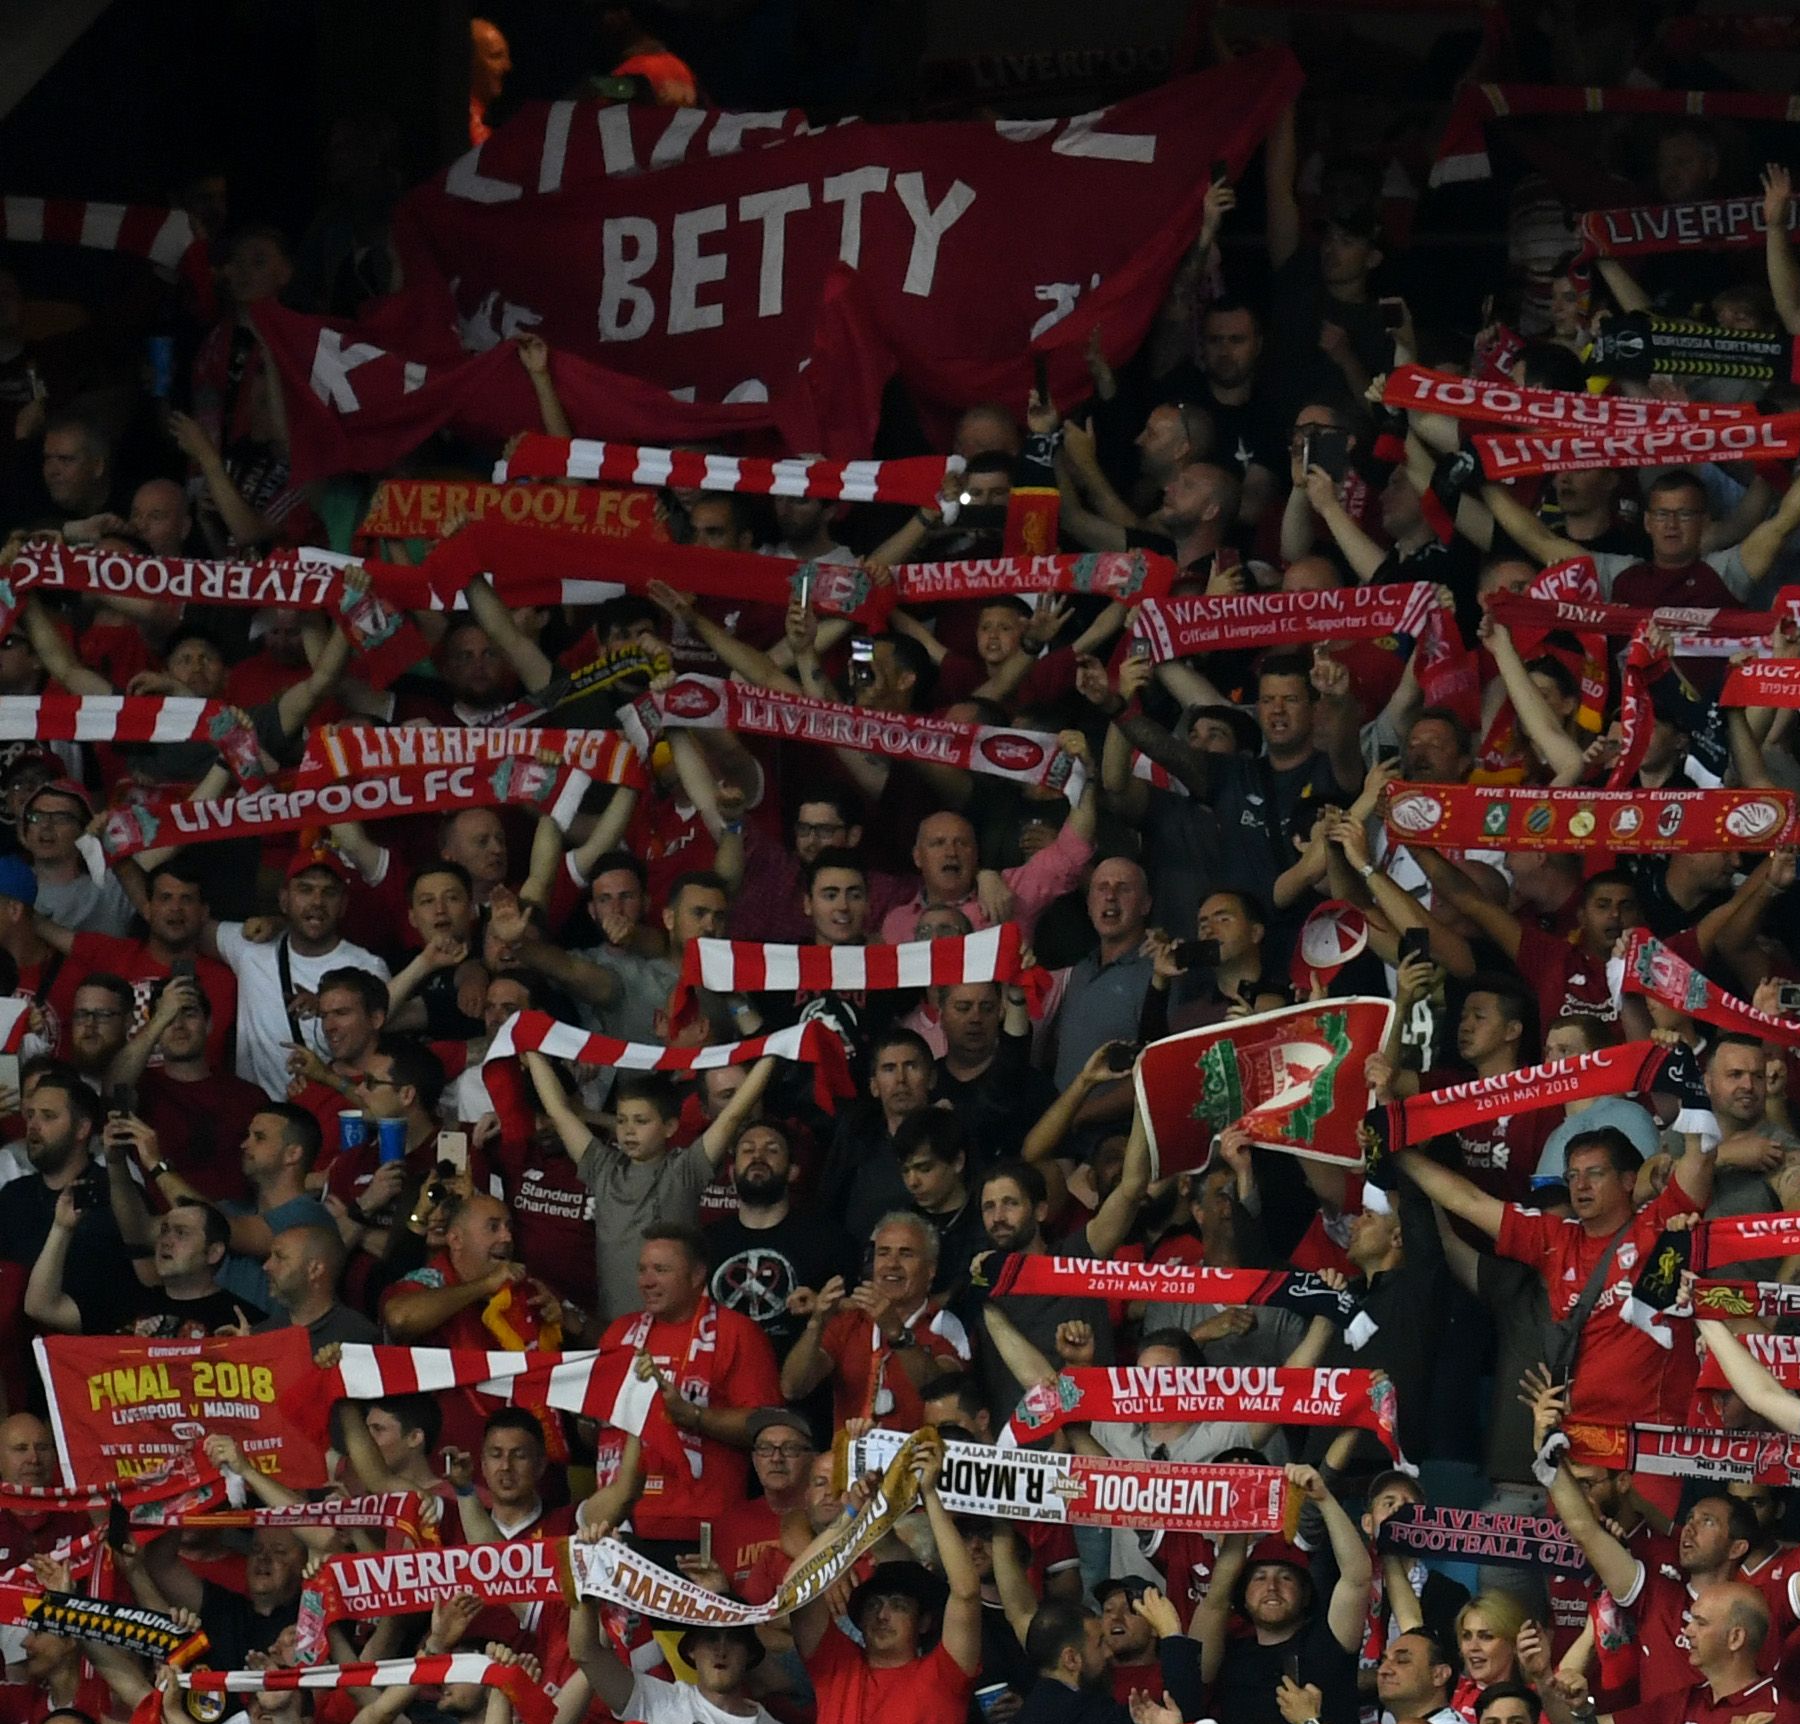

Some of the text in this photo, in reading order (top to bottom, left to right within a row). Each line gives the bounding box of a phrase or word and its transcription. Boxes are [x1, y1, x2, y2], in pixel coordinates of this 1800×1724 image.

[599, 167, 976, 342] BETTY
[1490, 425, 1791, 468] LIVERPOOL
[1168, 583, 1404, 626] WASHINGTON, D.C.
[1178, 622, 1221, 645] Official
[1224, 619, 1277, 641] Liverpool
[1306, 611, 1370, 635] Supporters
[1372, 608, 1399, 630] Club
[740, 698, 962, 763] LIVERPOOL
[173, 765, 475, 833] LIVERPOOL FC
[1475, 787, 1704, 803] FIVE TIMES CHAMPIONS EUROPE
[88, 1362, 278, 1412] FINAL 2018
[111, 1403, 186, 1425] LIVERPOOL
[203, 1401, 260, 1421] MADRID
[333, 1541, 554, 1598] LIVERPOOL
